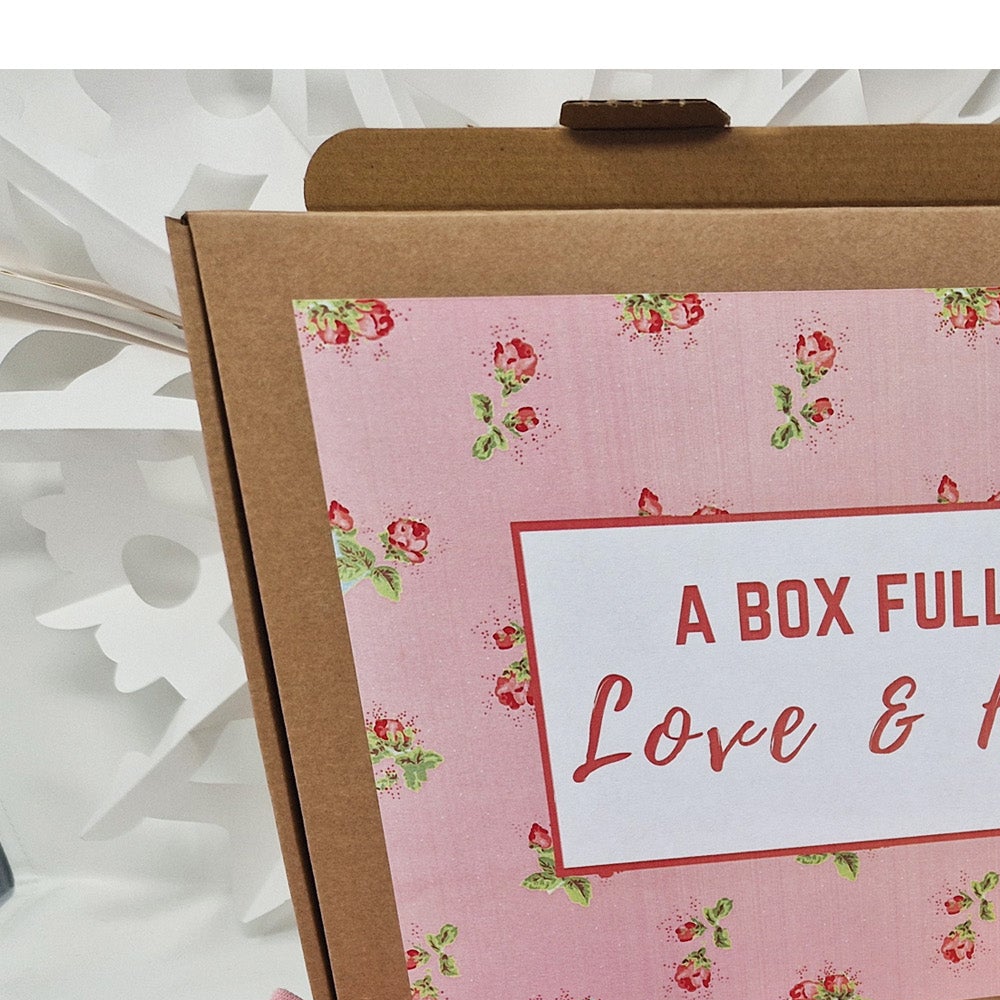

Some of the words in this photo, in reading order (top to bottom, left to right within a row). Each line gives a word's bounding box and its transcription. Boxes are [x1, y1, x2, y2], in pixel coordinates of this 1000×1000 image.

[675, 584, 716, 646] A
[736, 575, 855, 642] BOX
[572, 673, 818, 783] Love
[867, 675, 926, 755] &
